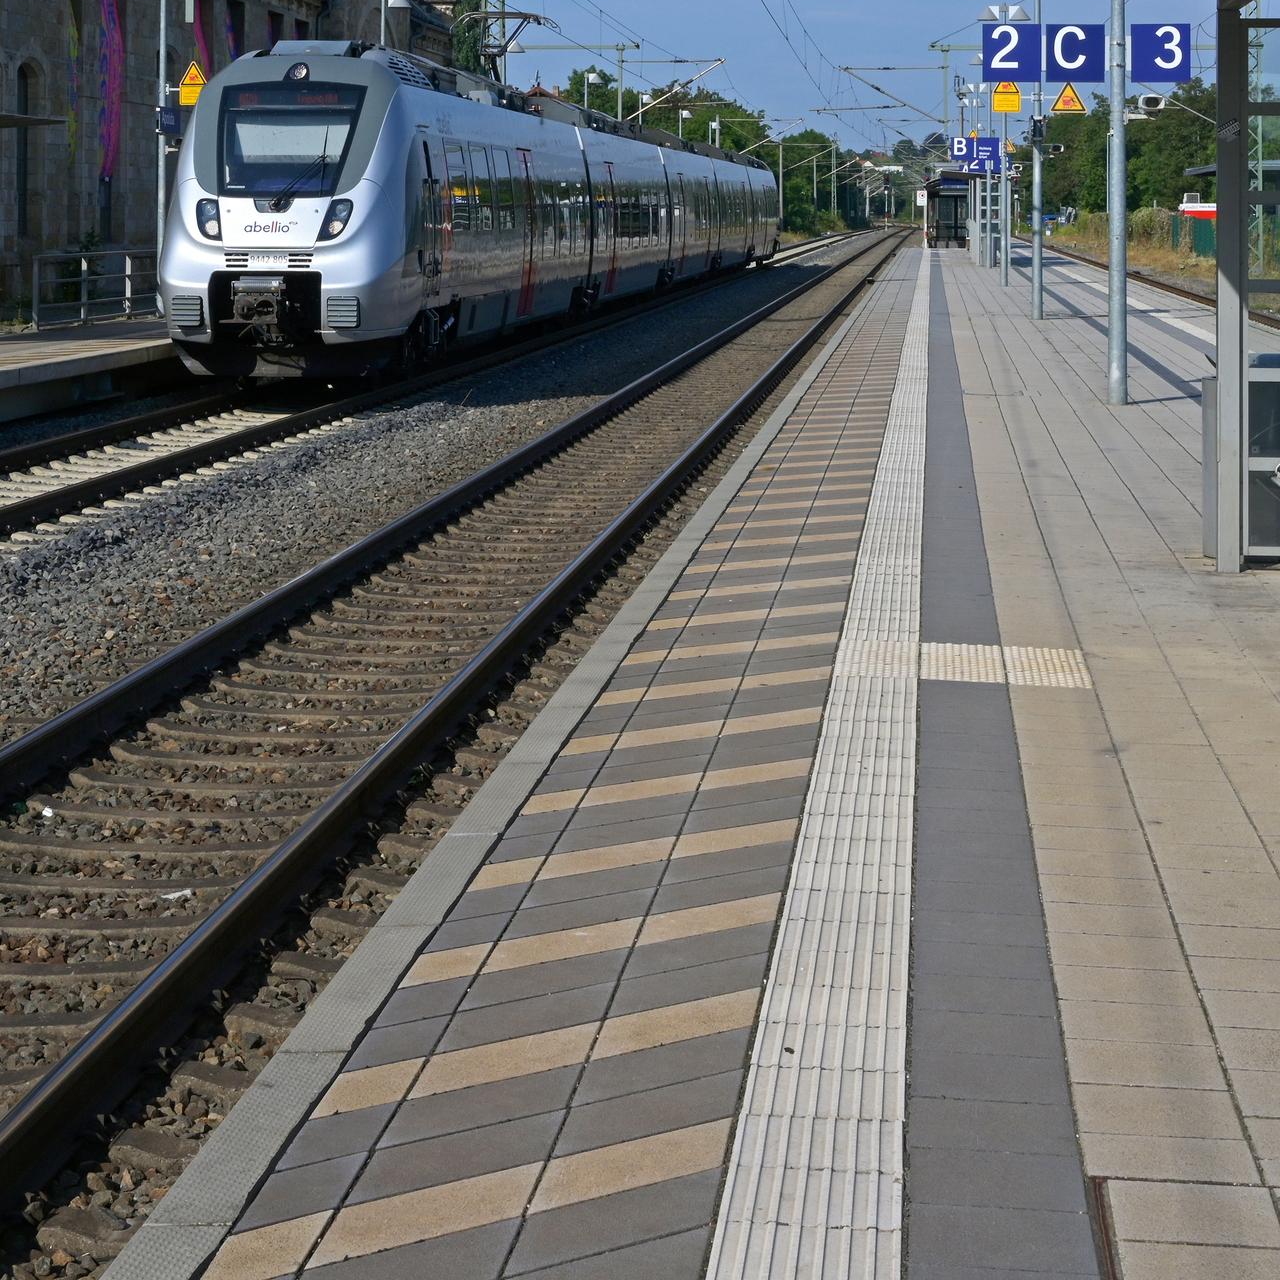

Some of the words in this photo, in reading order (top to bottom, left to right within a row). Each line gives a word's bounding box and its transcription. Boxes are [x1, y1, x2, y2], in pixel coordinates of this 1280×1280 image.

[991, 25, 1019, 69] 2
[1053, 25, 1087, 70] C
[1153, 25, 1183, 70] 3
[953, 137, 968, 156] B
[244, 221, 290, 233] abellio
[250, 255, 271, 264] 9442
[272, 255, 288, 264] 805
